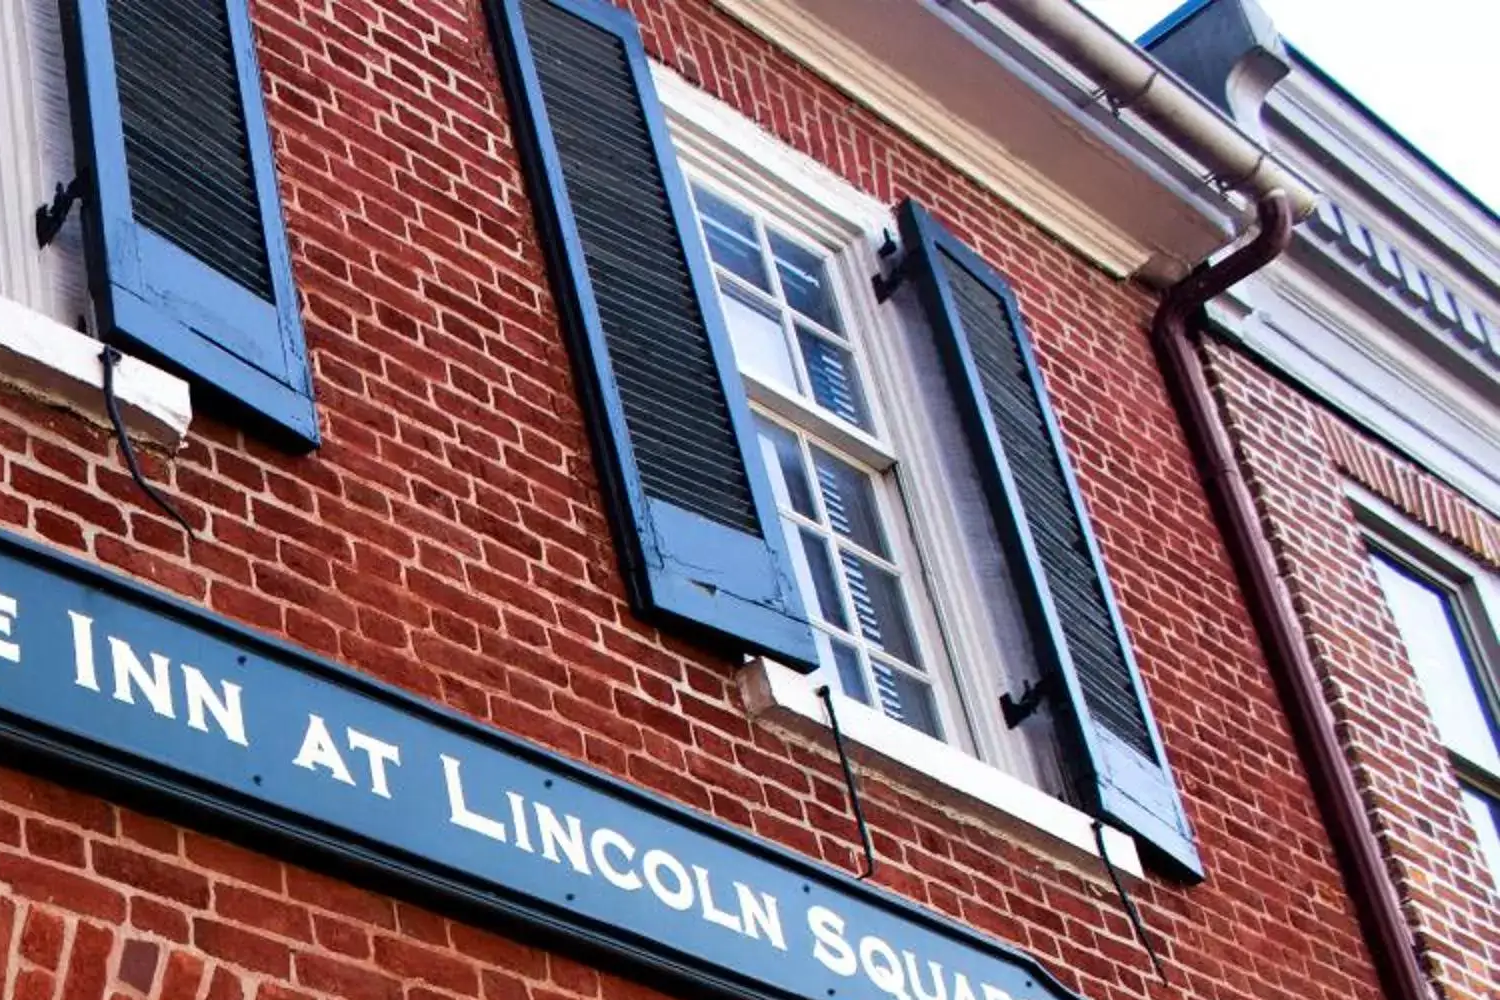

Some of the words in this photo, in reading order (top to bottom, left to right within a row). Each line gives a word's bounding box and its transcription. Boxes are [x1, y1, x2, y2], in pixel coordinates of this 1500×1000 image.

[67, 610, 249, 747] INN
[292, 714, 400, 799] AT
[439, 753, 788, 951] LINCOLN
